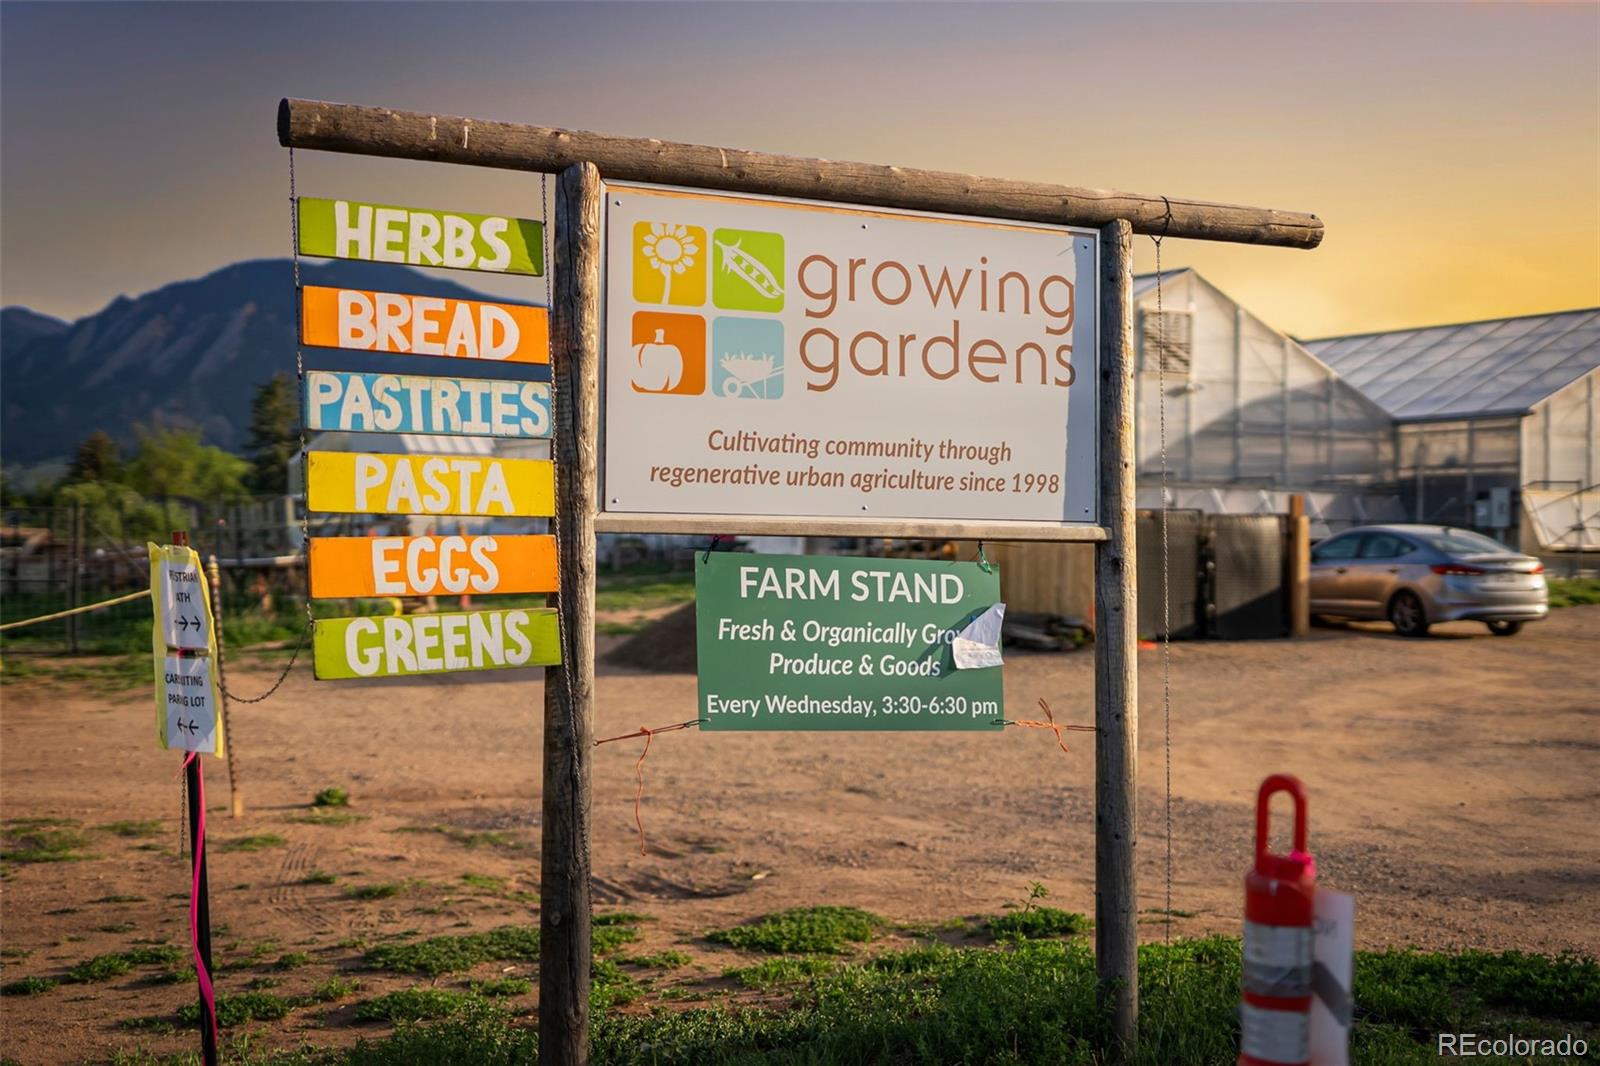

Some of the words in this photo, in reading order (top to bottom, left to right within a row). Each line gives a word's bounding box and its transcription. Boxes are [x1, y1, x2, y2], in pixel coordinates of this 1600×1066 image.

[334, 200, 512, 273] HERBS
[337, 288, 521, 361] BREAD
[797, 253, 1075, 336] growing
[799, 319, 1077, 393] gardens
[306, 372, 550, 436] PASTRIES
[708, 429, 820, 459] Cultivating
[825, 437, 934, 463] community
[938, 439, 1012, 466] through
[354, 454, 516, 514] PASTA
[650, 463, 781, 488] regenerative
[786, 465, 844, 488] urban
[850, 468, 955, 493] agriculture
[959, 471, 1006, 492] since
[1011, 473, 1060, 494] 1998
[371, 535, 500, 595] EGGS
[739, 566, 841, 601] FARM
[850, 569, 964, 604] STAND
[344, 610, 533, 677] GREENS
[717, 617, 775, 642] Fresh
[780, 619, 797, 642] &
[802, 620, 918, 649] Organically
[921, 622, 961, 646] Gro
[768, 653, 853, 676] Produce
[858, 654, 874, 676] &
[879, 654, 941, 677] Goods
[706, 694, 760, 717] Every
[764, 694, 877, 718] Wednesday,
[881, 696, 968, 716] 3:30-6:30
[971, 700, 998, 718] pm
